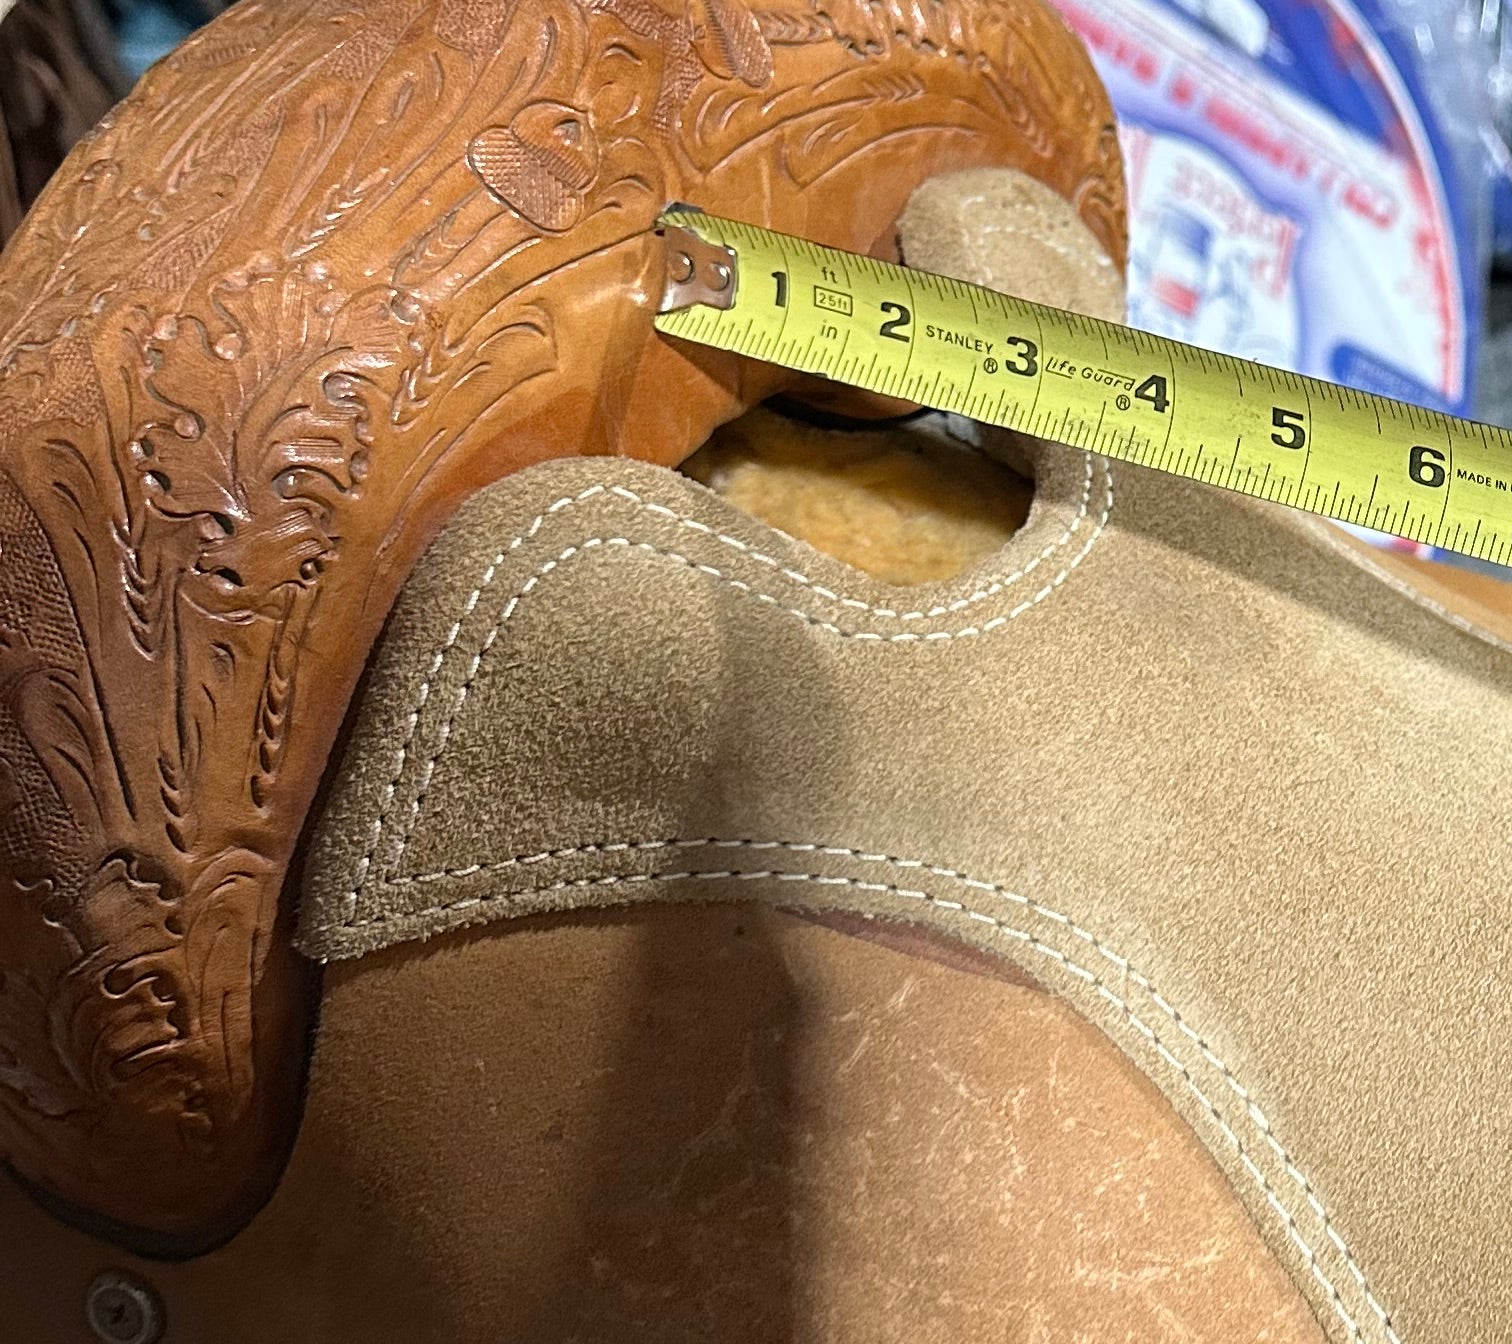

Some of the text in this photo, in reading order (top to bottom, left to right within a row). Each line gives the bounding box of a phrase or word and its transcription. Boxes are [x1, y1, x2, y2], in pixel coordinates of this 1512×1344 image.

[771, 271, 787, 308] 1
[821, 266, 838, 284] ft
[817, 291, 850, 311] 25ft
[820, 323, 838, 340] in
[879, 301, 911, 343] 2
[925, 324, 994, 354] STANLEY
[1005, 336, 1039, 377] 3
[1134, 374, 1170, 413] 4
[1270, 407, 1306, 450] 5
[1408, 446, 1446, 488] 6
[1456, 468, 1492, 488] MADE
[1495, 479, 1508, 492] IN
